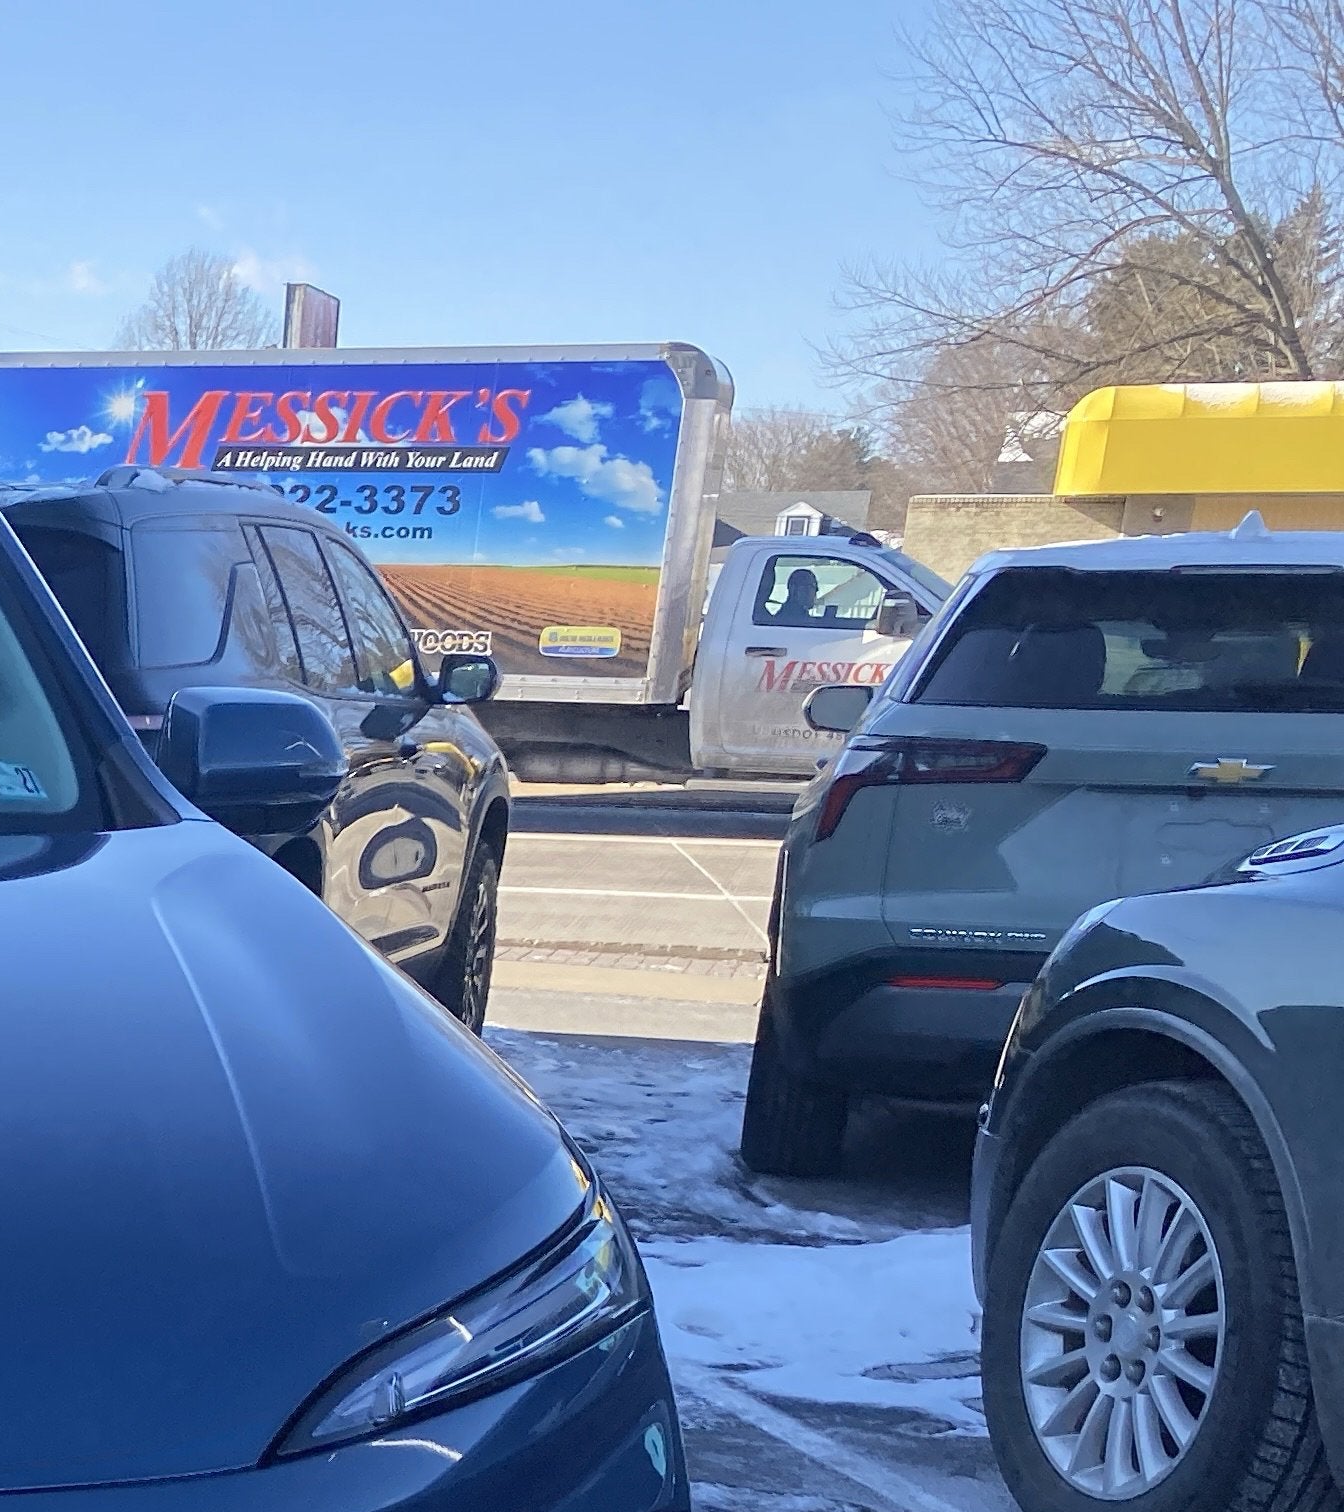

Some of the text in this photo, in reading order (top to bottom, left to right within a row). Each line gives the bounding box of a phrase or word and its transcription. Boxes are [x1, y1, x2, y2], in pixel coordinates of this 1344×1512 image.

[123, 387, 532, 469] MESSICK'S
[217, 451, 500, 471] A Helping Hand With Your Land
[270, 484, 462, 515] 22-3373
